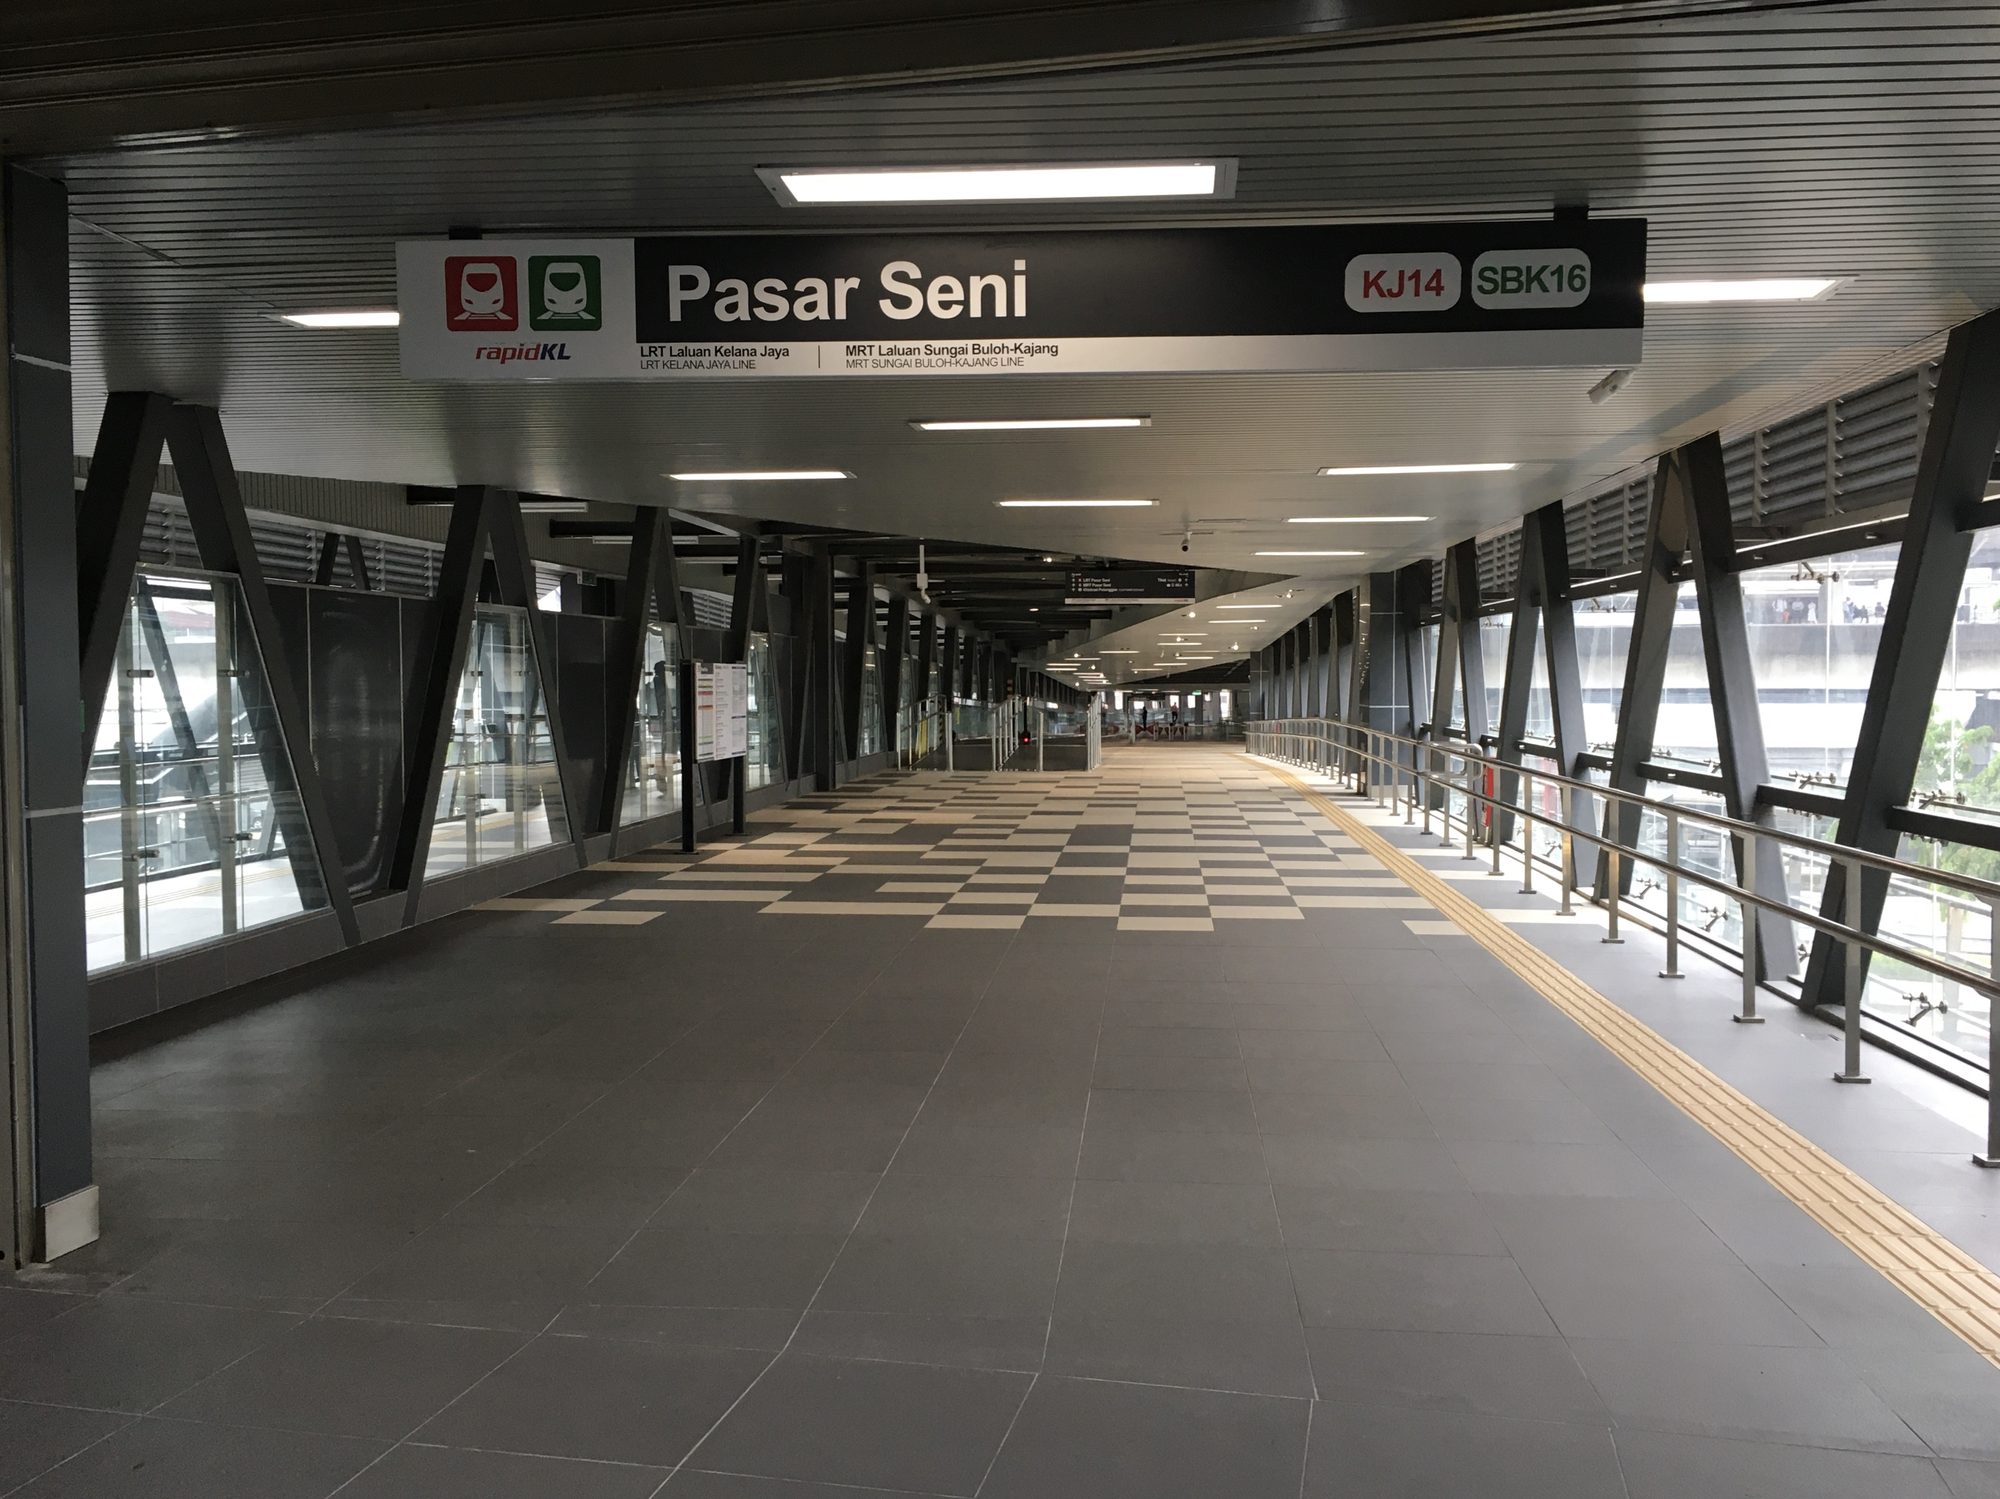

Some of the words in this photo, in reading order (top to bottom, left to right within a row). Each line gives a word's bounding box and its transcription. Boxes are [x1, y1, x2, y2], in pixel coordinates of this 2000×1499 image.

[1362, 268, 1445, 299] KJ14
[1476, 264, 1587, 295] SBK16
[667, 264, 860, 322] Pasar
[878, 260, 1027, 319] Seni
[476, 342, 571, 364] rapidKL
[640, 346, 666, 357] LRT
[669, 345, 712, 357] Laluan
[715, 345, 757, 357] Kelana
[760, 345, 789, 359] Jaya
[846, 345, 874, 356] MRT
[878, 344, 921, 356] Laluan
[924, 344, 968, 358] Sungai
[972, 342, 1059, 357] Buloh-Kajang
[640, 360, 661, 369] LRT
[662, 360, 706, 369] KELANA
[706, 360, 731, 369] JAYA
[733, 360, 756, 369] LINE
[846, 359, 869, 369] MRT
[872, 358, 913, 368] SUNGAI
[915, 357, 999, 368] BULOH-KAJANG
[1000, 357, 1025, 367] LINE
